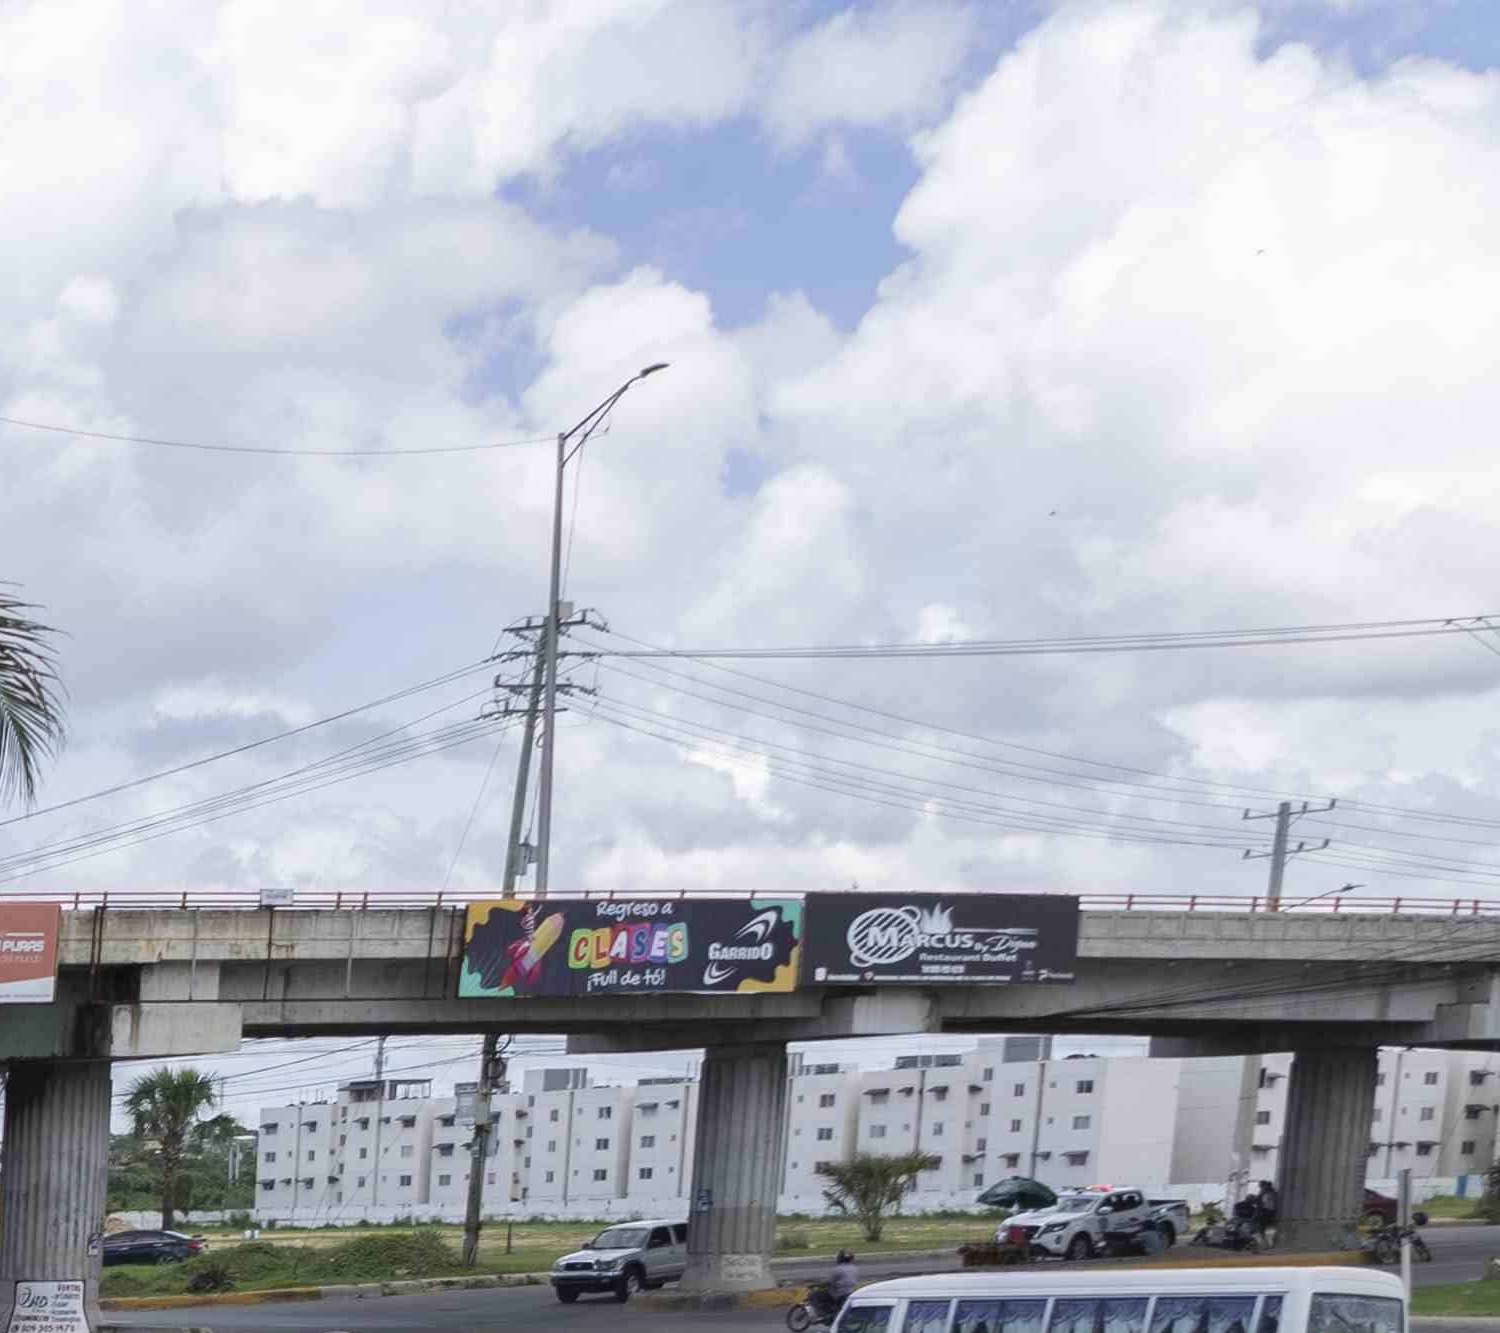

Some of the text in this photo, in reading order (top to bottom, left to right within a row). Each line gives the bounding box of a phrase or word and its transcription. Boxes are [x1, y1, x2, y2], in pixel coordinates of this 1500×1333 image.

[596, 901, 674, 922] Regreso a
[2, 940, 45, 952] PURAS
[573, 928, 686, 963] CLASES
[919, 952, 1018, 963] Restaurant Buffet
[620, 970, 641, 984] de
